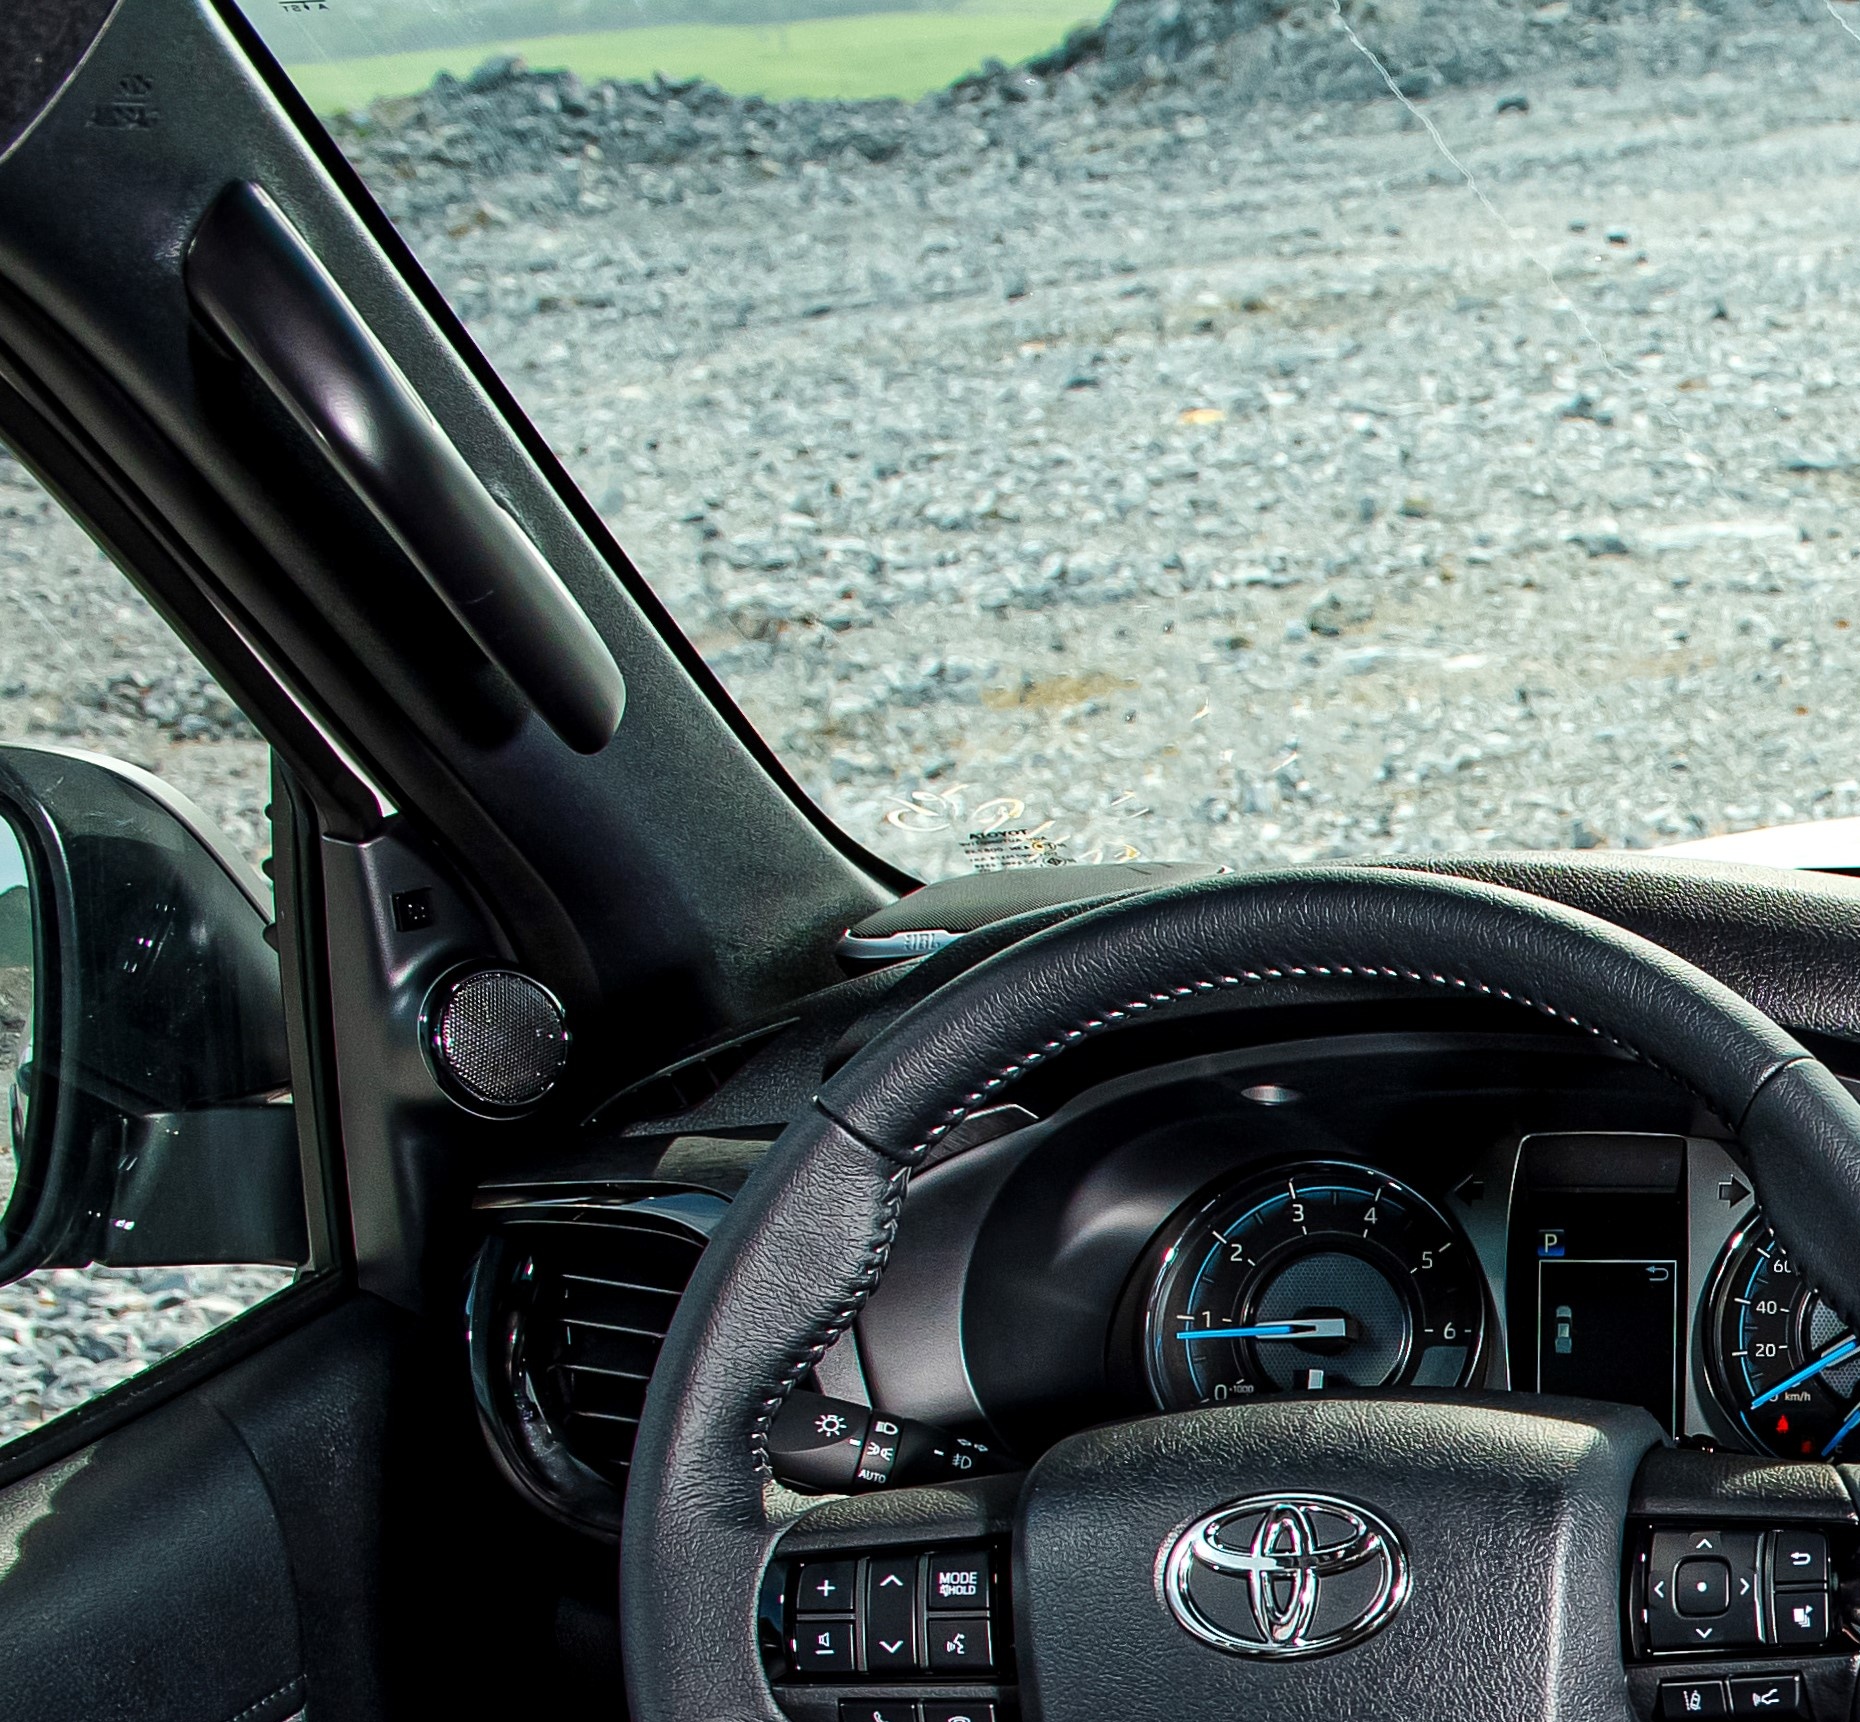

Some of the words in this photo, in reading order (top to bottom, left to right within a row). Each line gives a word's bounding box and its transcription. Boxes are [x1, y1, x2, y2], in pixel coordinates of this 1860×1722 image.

[1292, 1204, 1304, 1222] 3
[1364, 1206, 1378, 1225] 4
[1544, 1233, 1558, 1253] P
[1230, 1243, 1243, 1262] 2
[1421, 1250, 1433, 1269] 5
[1755, 1300, 1778, 1315] 40
[1201, 1310, 1212, 1328] 1
[1443, 1322, 1457, 1340] 6
[1755, 1343, 1776, 1357] 20
[1213, 1384, 1228, 1401] 0
[1784, 1391, 1812, 1402] km/h
[858, 1468, 886, 1484] AUTO
[938, 1571, 978, 1585] MODE
[948, 1584, 977, 1596] HOLD
